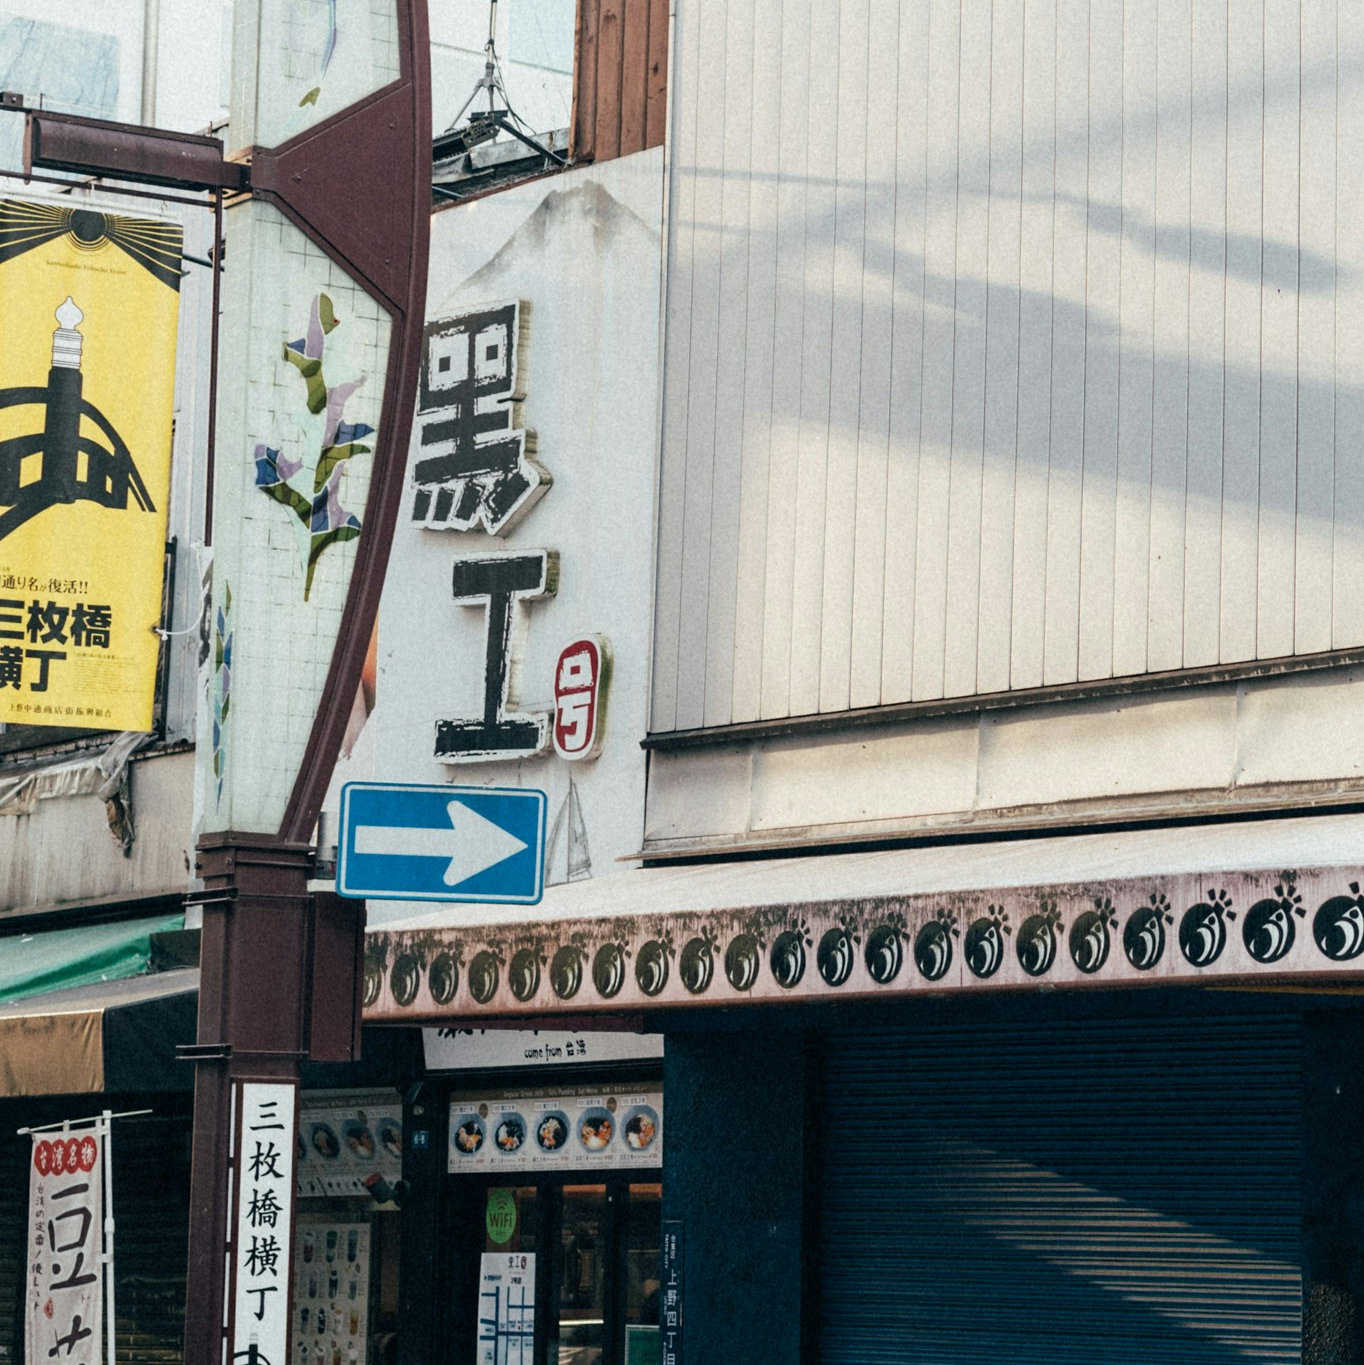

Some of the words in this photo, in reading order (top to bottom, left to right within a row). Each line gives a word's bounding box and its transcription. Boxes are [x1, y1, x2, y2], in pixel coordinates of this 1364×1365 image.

[524, 1048, 543, 1059] come
[545, 1044, 562, 1062] from
[39, 1141, 95, 1170] 台湾名物
[243, 1101, 285, 1322] 三枚橋横丁
[489, 1212, 513, 1228] WiFi
